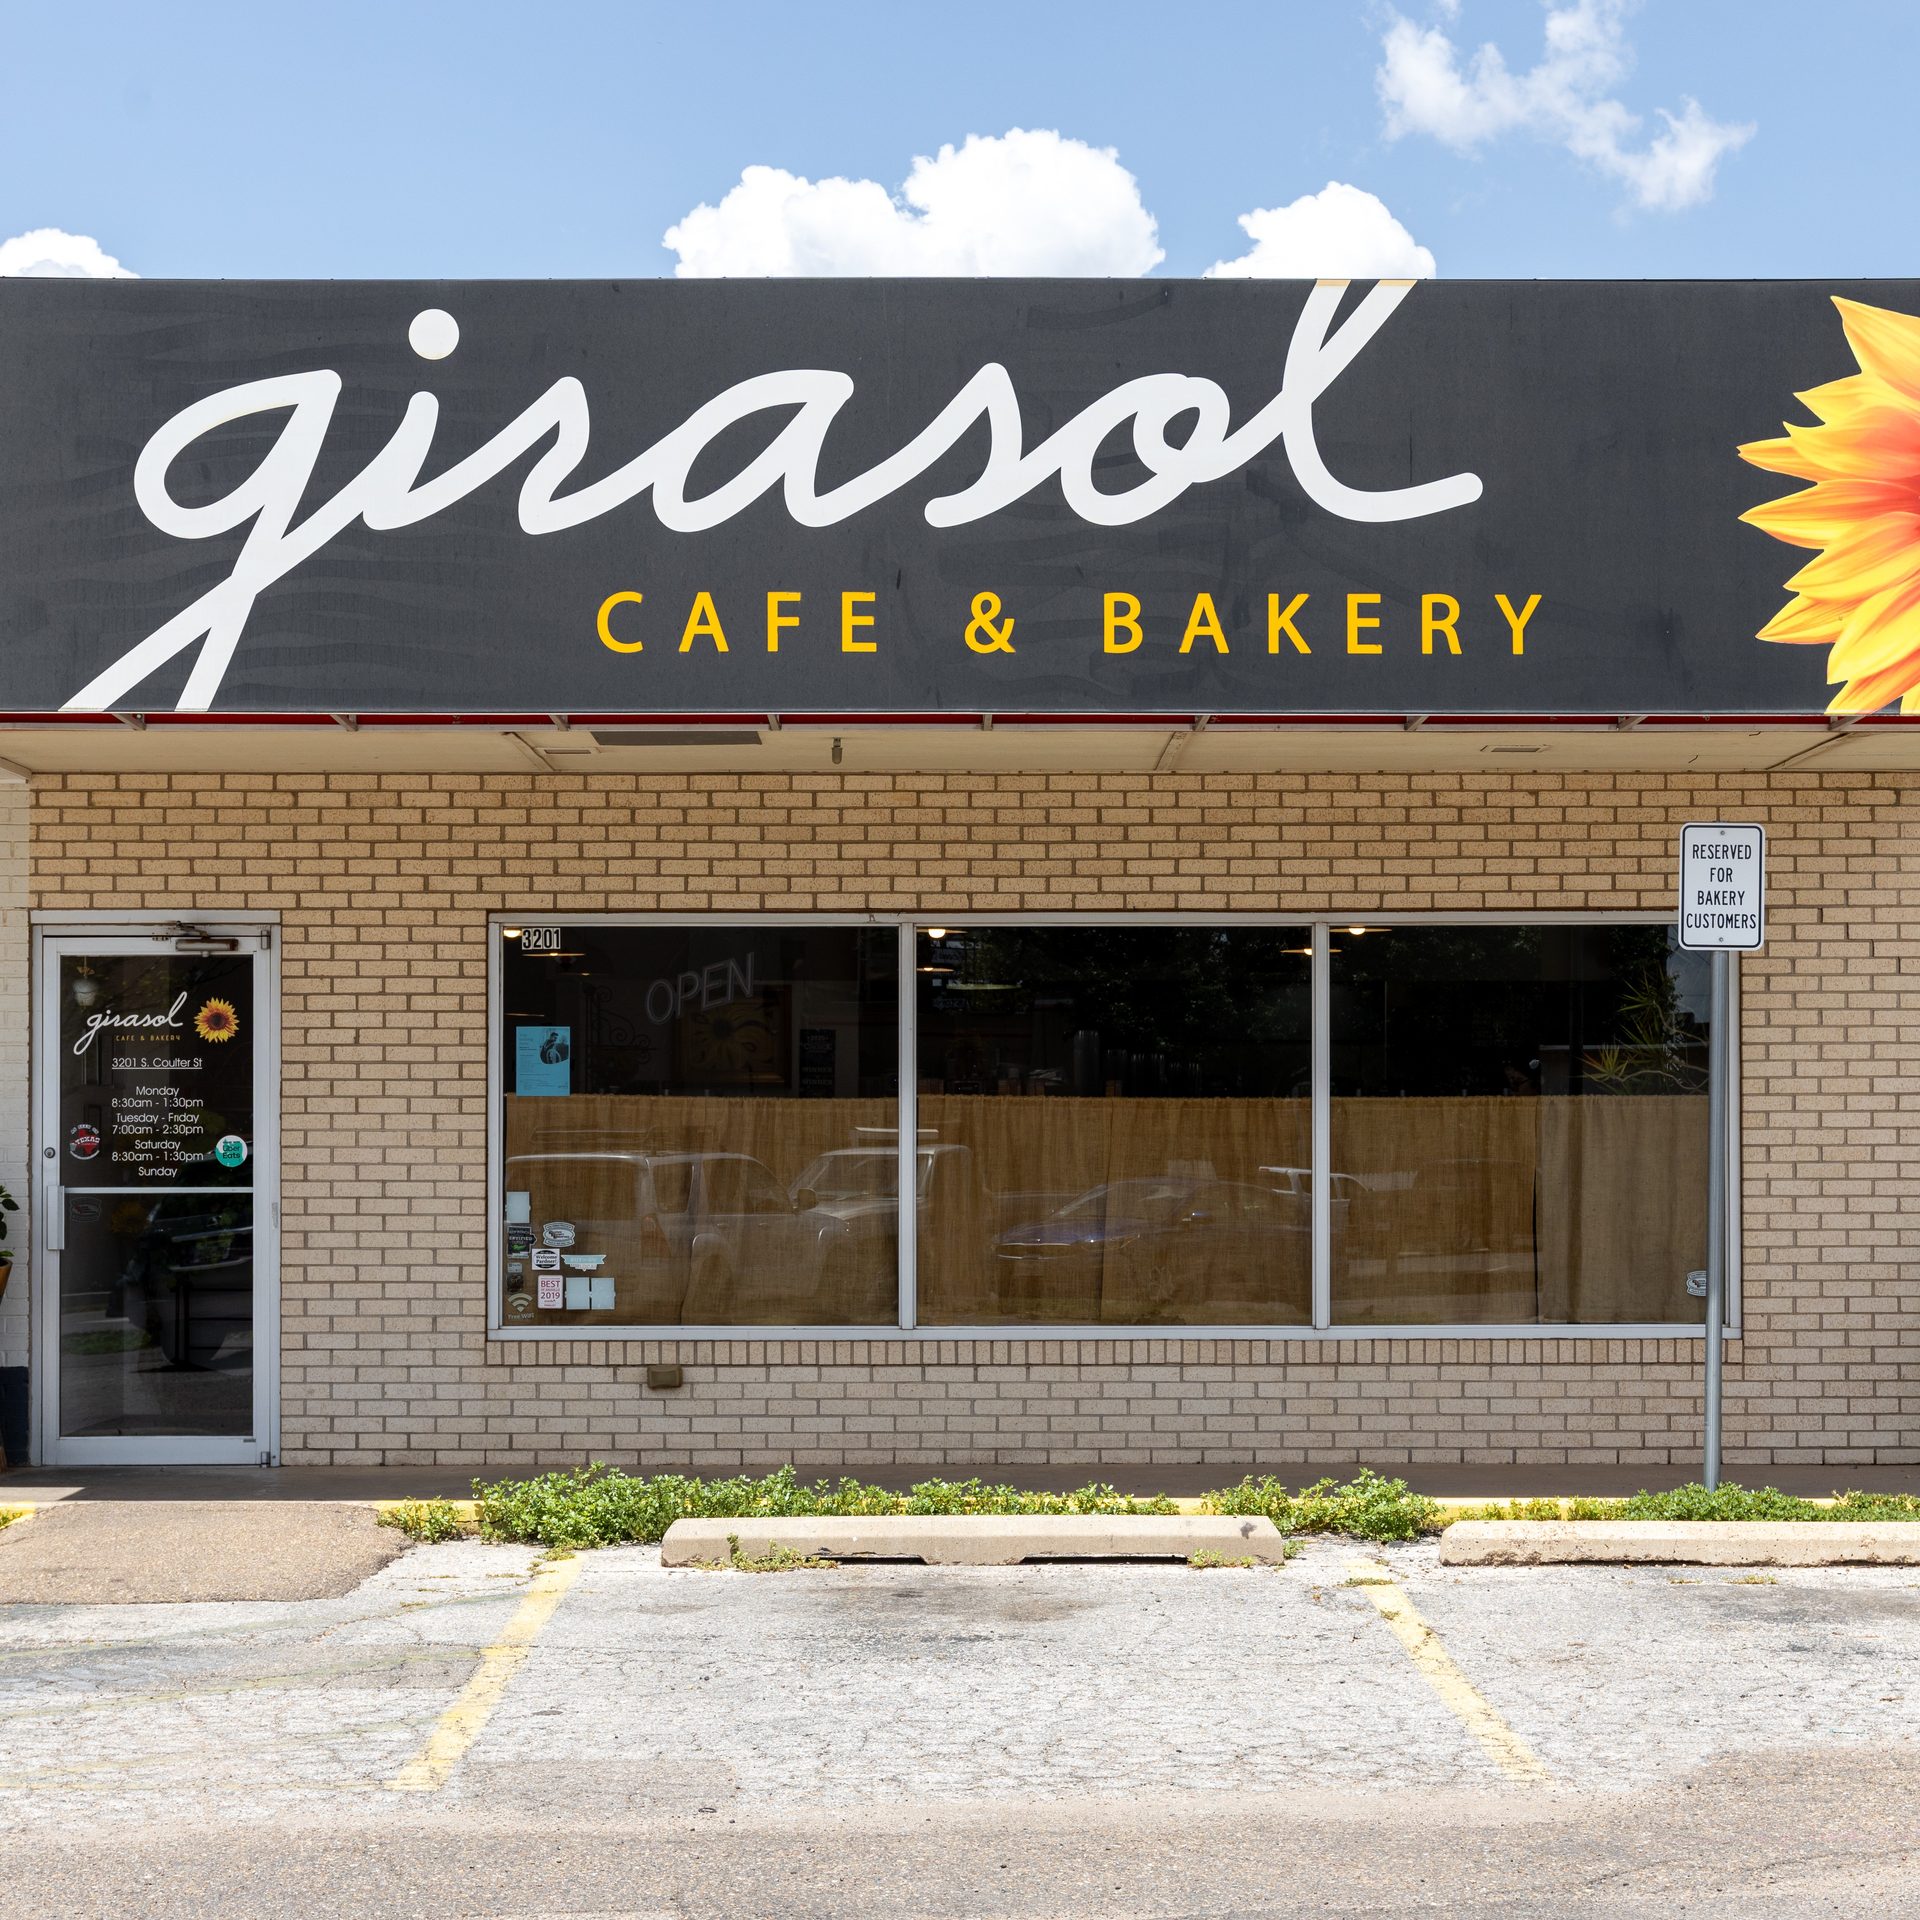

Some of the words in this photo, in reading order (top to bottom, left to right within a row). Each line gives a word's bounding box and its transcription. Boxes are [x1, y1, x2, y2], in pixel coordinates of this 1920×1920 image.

[59, 279, 1484, 712] girasol
[597, 591, 877, 653] CAFE
[965, 592, 1016, 654] &
[1104, 593, 1542, 655] BAKERY
[1692, 844, 1752, 860] RESERVED
[1710, 867, 1733, 882] FOR
[1697, 890, 1745, 906] BAKERY
[1686, 913, 1757, 929] CUSTOMERS
[523, 929, 560, 950] 3201
[646, 952, 754, 1025] OPEN
[73, 991, 188, 1055] girasol
[112, 1057, 137, 1067] 3201
[140, 1057, 150, 1067] S.
[153, 1057, 191, 1067] Coulter
[193, 1057, 203, 1067] St
[135, 1086, 179, 1098] Monday
[111, 1098, 153, 1108] 8:30am
[163, 1098, 204, 1110] 1:30pm
[117, 1113, 159, 1124] Tuesday
[168, 1113, 200, 1124] Friday
[112, 1125, 153, 1135] 7:00am
[162, 1125, 204, 1136] 2:30pm
[134, 1140, 181, 1151] Saturday
[111, 1152, 153, 1162] 8:30am
[163, 1151, 204, 1163] 1:30pm
[138, 1167, 178, 1178] Sunday
[540, 1280, 561, 1288] BEST
[540, 1291, 561, 1300] 2019
